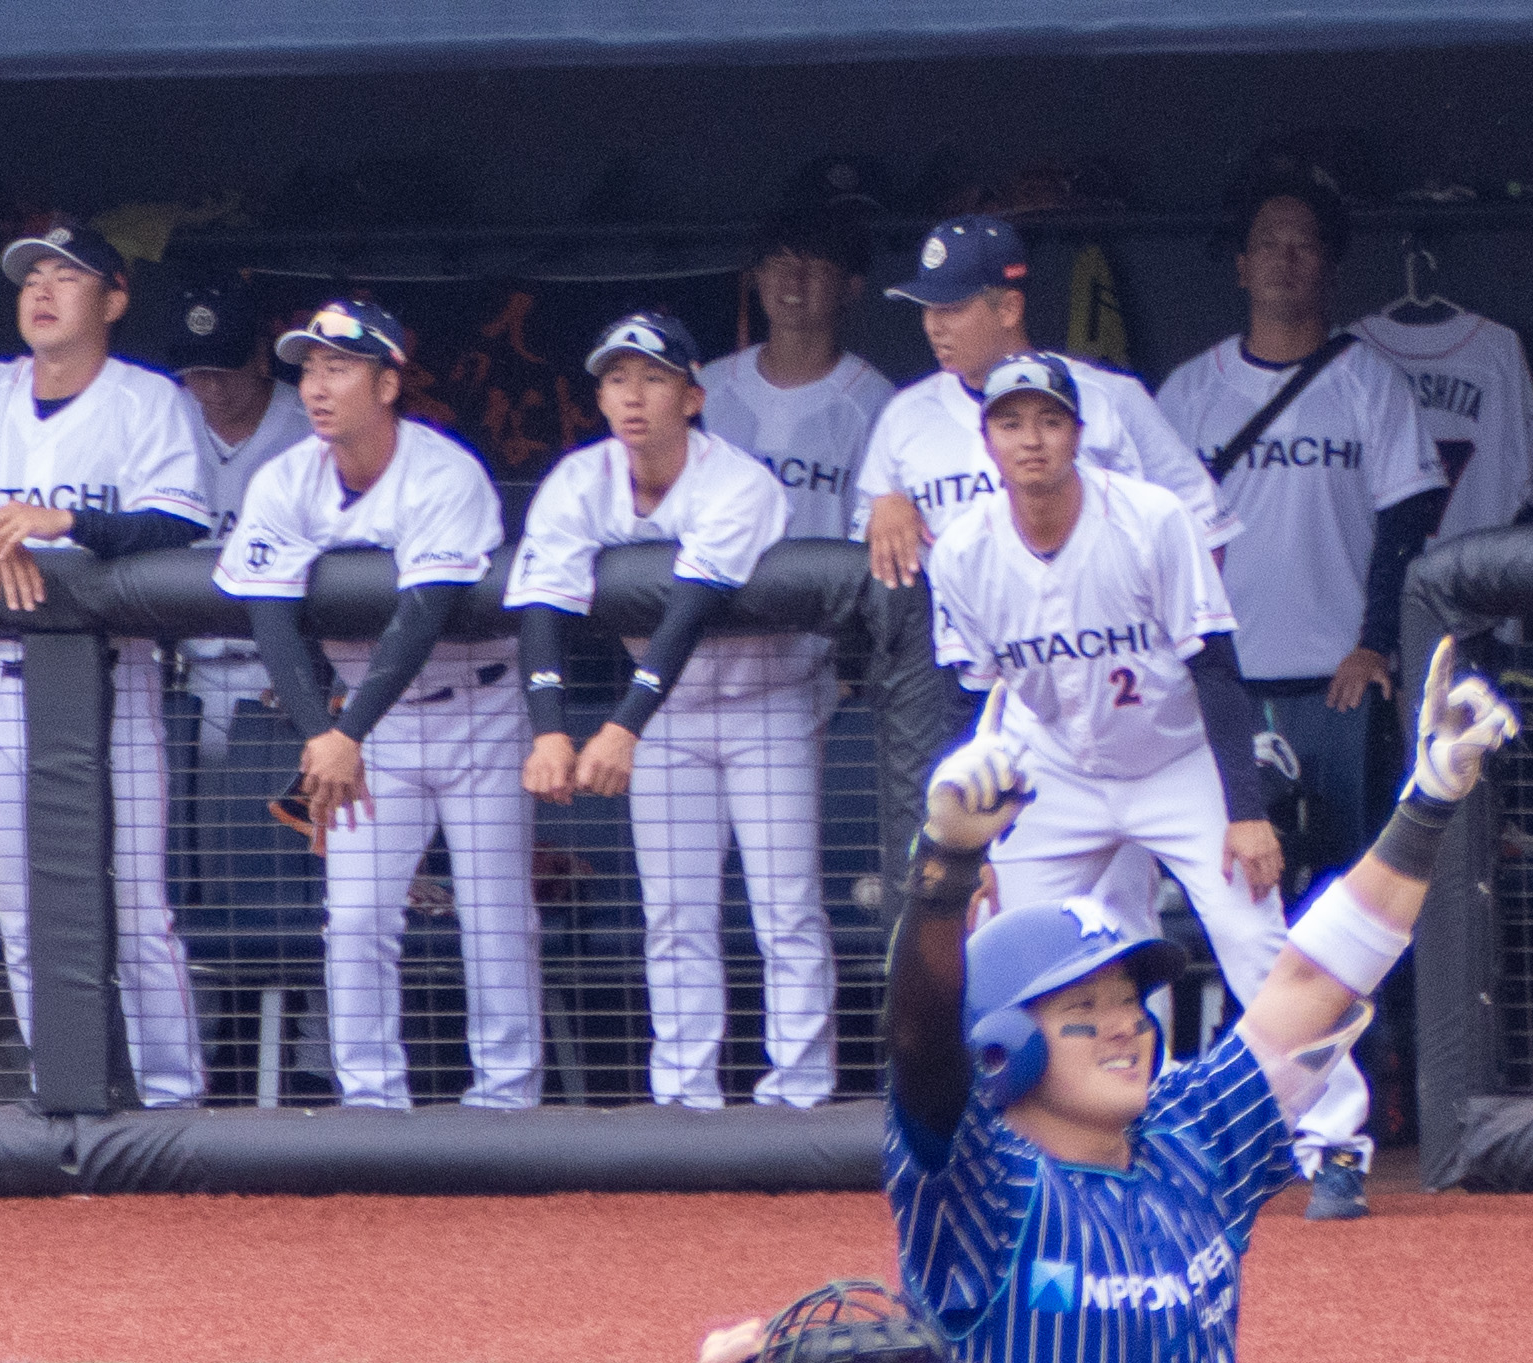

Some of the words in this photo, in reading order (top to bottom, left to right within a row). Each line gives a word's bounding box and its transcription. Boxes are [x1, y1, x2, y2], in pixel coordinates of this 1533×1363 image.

[1197, 436, 1363, 470] HTACHI
[911, 470, 1002, 511] HITA
[992, 622, 1151, 669] HITACHI
[1109, 666, 1142, 708] 2
